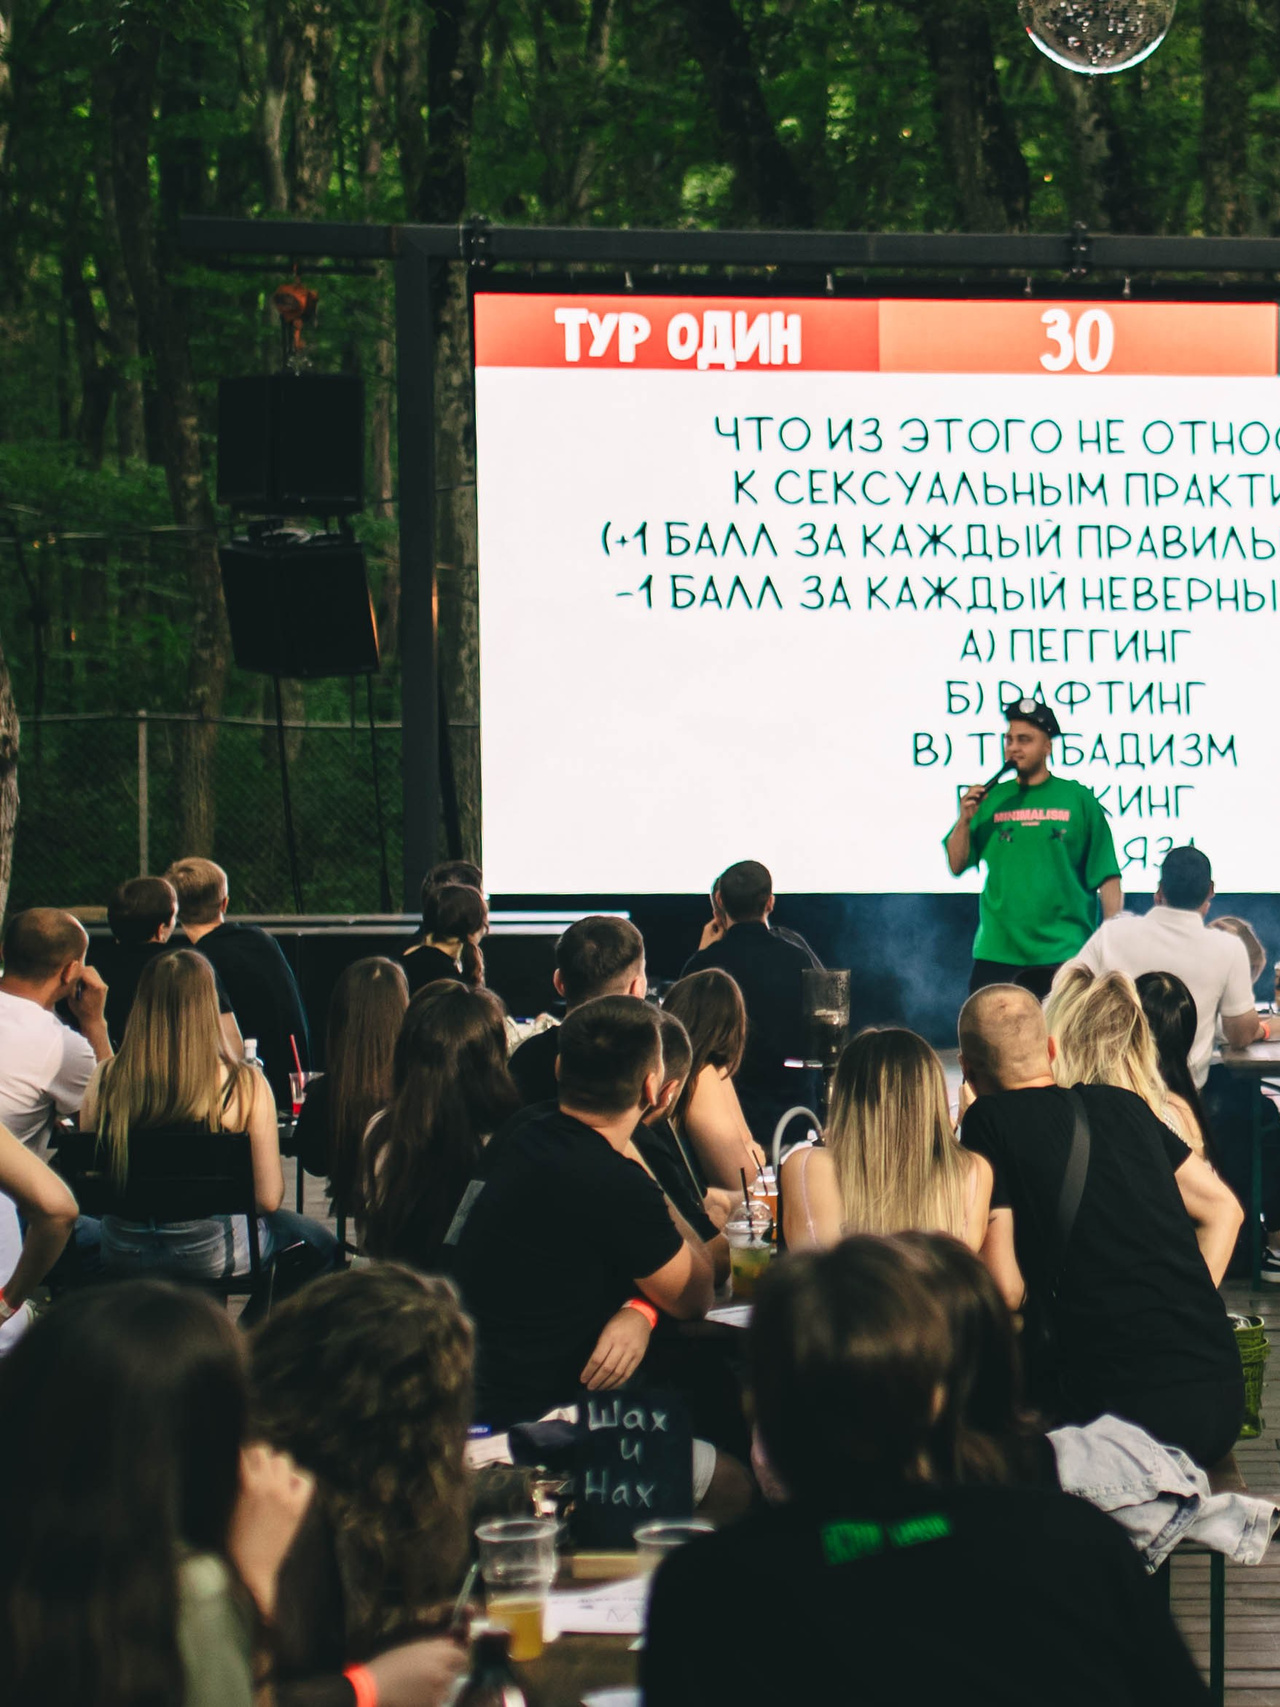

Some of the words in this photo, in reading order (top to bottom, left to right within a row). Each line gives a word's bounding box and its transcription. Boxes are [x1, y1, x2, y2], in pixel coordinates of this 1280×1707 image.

[554, 307, 651, 363] ТУР
[667, 310, 801, 370] ОДИН
[1039, 308, 1114, 372] 30
[714, 415, 812, 453] ЧТО
[826, 416, 883, 453] ИЗ
[899, 416, 1063, 455] ЭТОГО
[1078, 418, 1126, 455] НЕ
[733, 469, 759, 505] К
[774, 468, 1109, 507] СЕКСУАЛЬНЫМ
[601, 520, 648, 558] (+1
[664, 521, 779, 558] БАЛЛ
[794, 522, 847, 559] ЗА
[861, 518, 1062, 562] КАЖДЫЙ
[615, 573, 653, 610] -1
[669, 573, 784, 611] БАЛЛ
[799, 574, 852, 612] ЗА
[866, 570, 1066, 616] КАЖДЫЙ
[960, 628, 996, 664] А)
[1009, 628, 1192, 664] ПЕГГИНГ
[945, 679, 985, 716] Б)
[912, 732, 953, 768] В)
[587, 1399, 669, 1432] Шах
[585, 1470, 656, 1508] Нах
